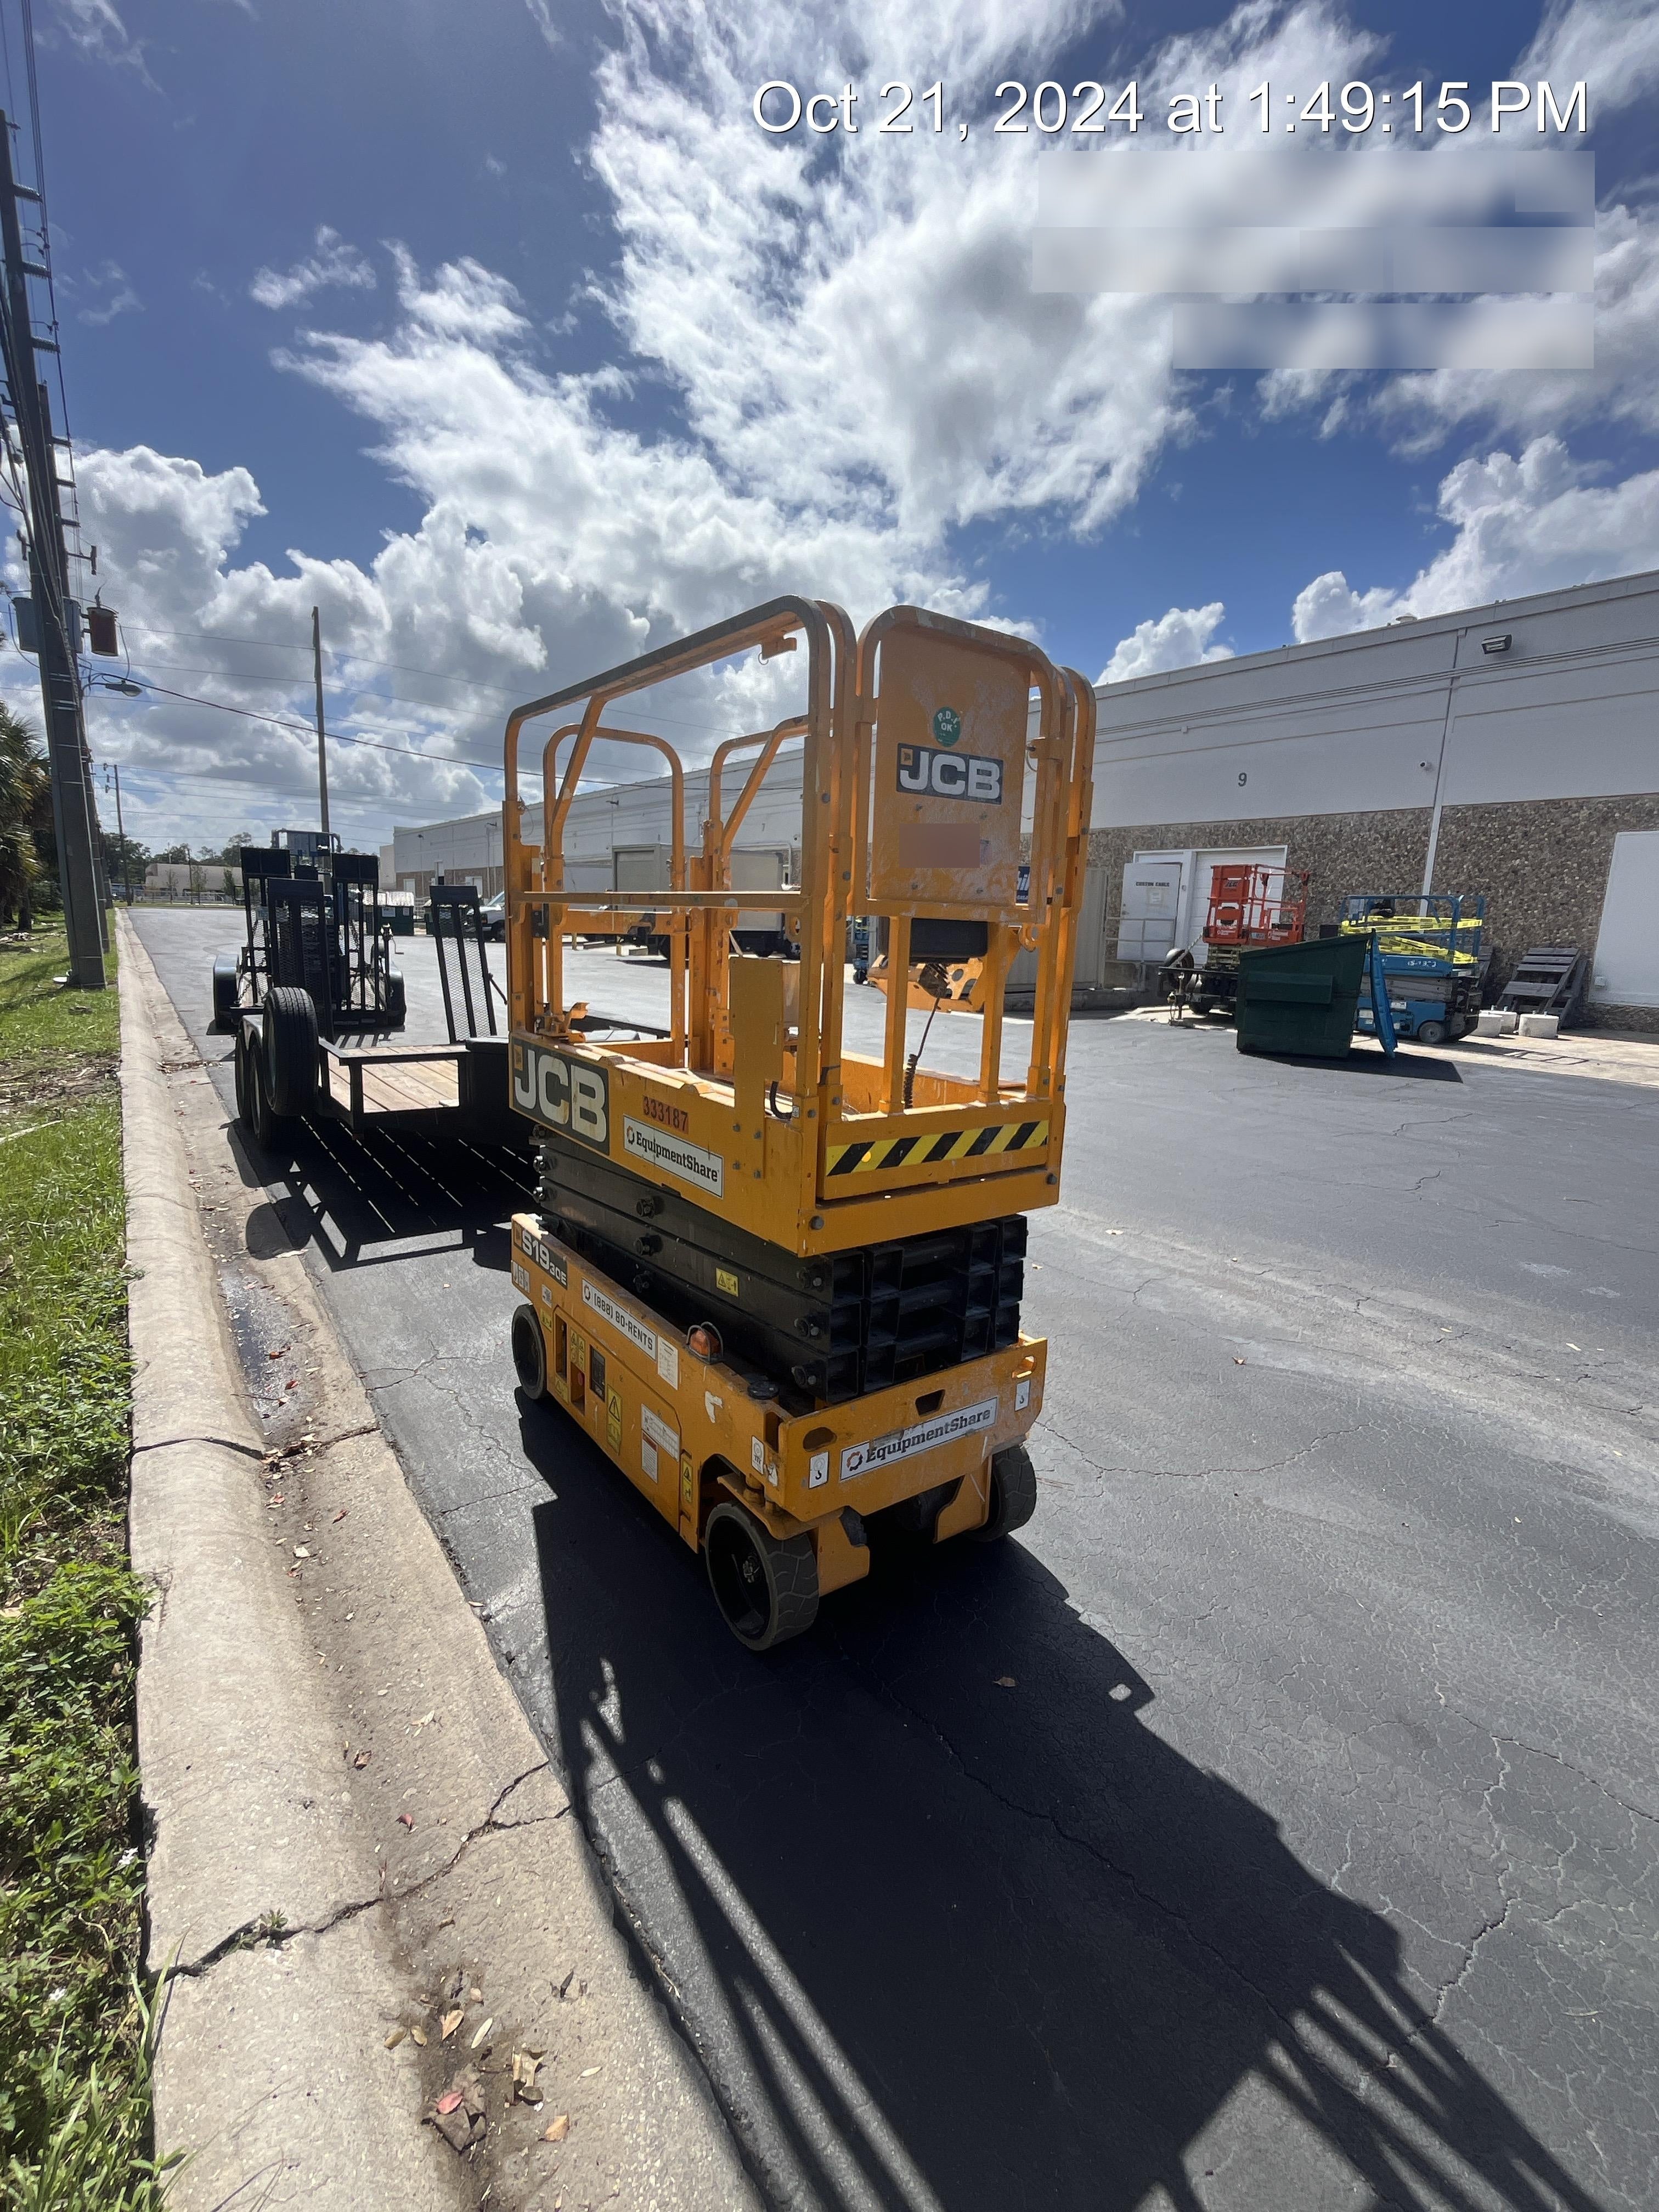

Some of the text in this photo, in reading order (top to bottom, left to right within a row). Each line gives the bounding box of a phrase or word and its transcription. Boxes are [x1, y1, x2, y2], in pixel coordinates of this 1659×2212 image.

[941, 723, 953, 732] OK
[900, 751, 1000, 799] JCB
[1238, 772, 1247, 787] 9
[515, 1049, 607, 1143] JCB
[644, 1096, 688, 1132] 333187
[636, 1131, 718, 1182] EquipmentShare
[594, 1293, 613, 1319] (888)
[866, 1409, 991, 1463] EquipmentShare
